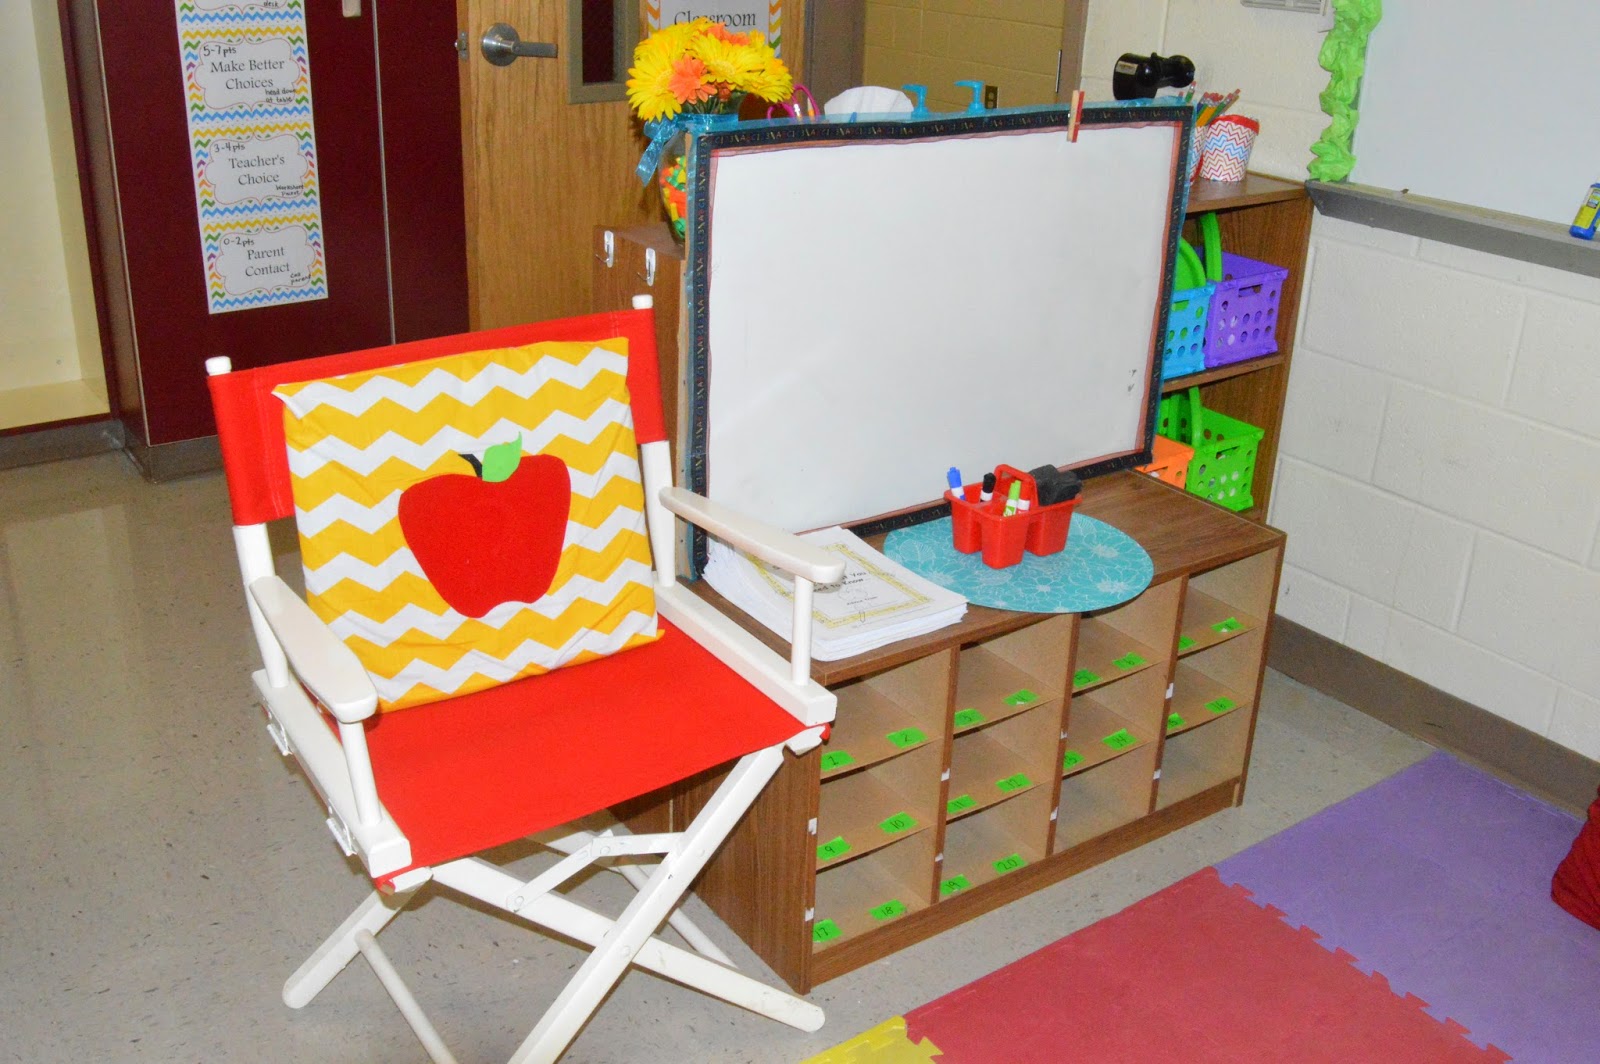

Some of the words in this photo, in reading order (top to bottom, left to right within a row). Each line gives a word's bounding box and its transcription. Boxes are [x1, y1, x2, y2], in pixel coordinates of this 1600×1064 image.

[674, 10, 756, 27] Clsroom
[210, 61, 245, 73] Make
[249, 59, 285, 71] Better
[225, 77, 274, 90] Choices
[228, 154, 285, 169] Teacher's
[238, 173, 280, 186] Choice
[247, 246, 285, 260] Parent
[245, 262, 290, 277] Contact
[827, 755, 839, 766] 1
[1006, 778, 1023, 789] 12
[890, 819, 905, 830] 10
[997, 858, 1018, 871] 20
[881, 906, 895, 917] 18
[814, 926, 829, 938] 17
